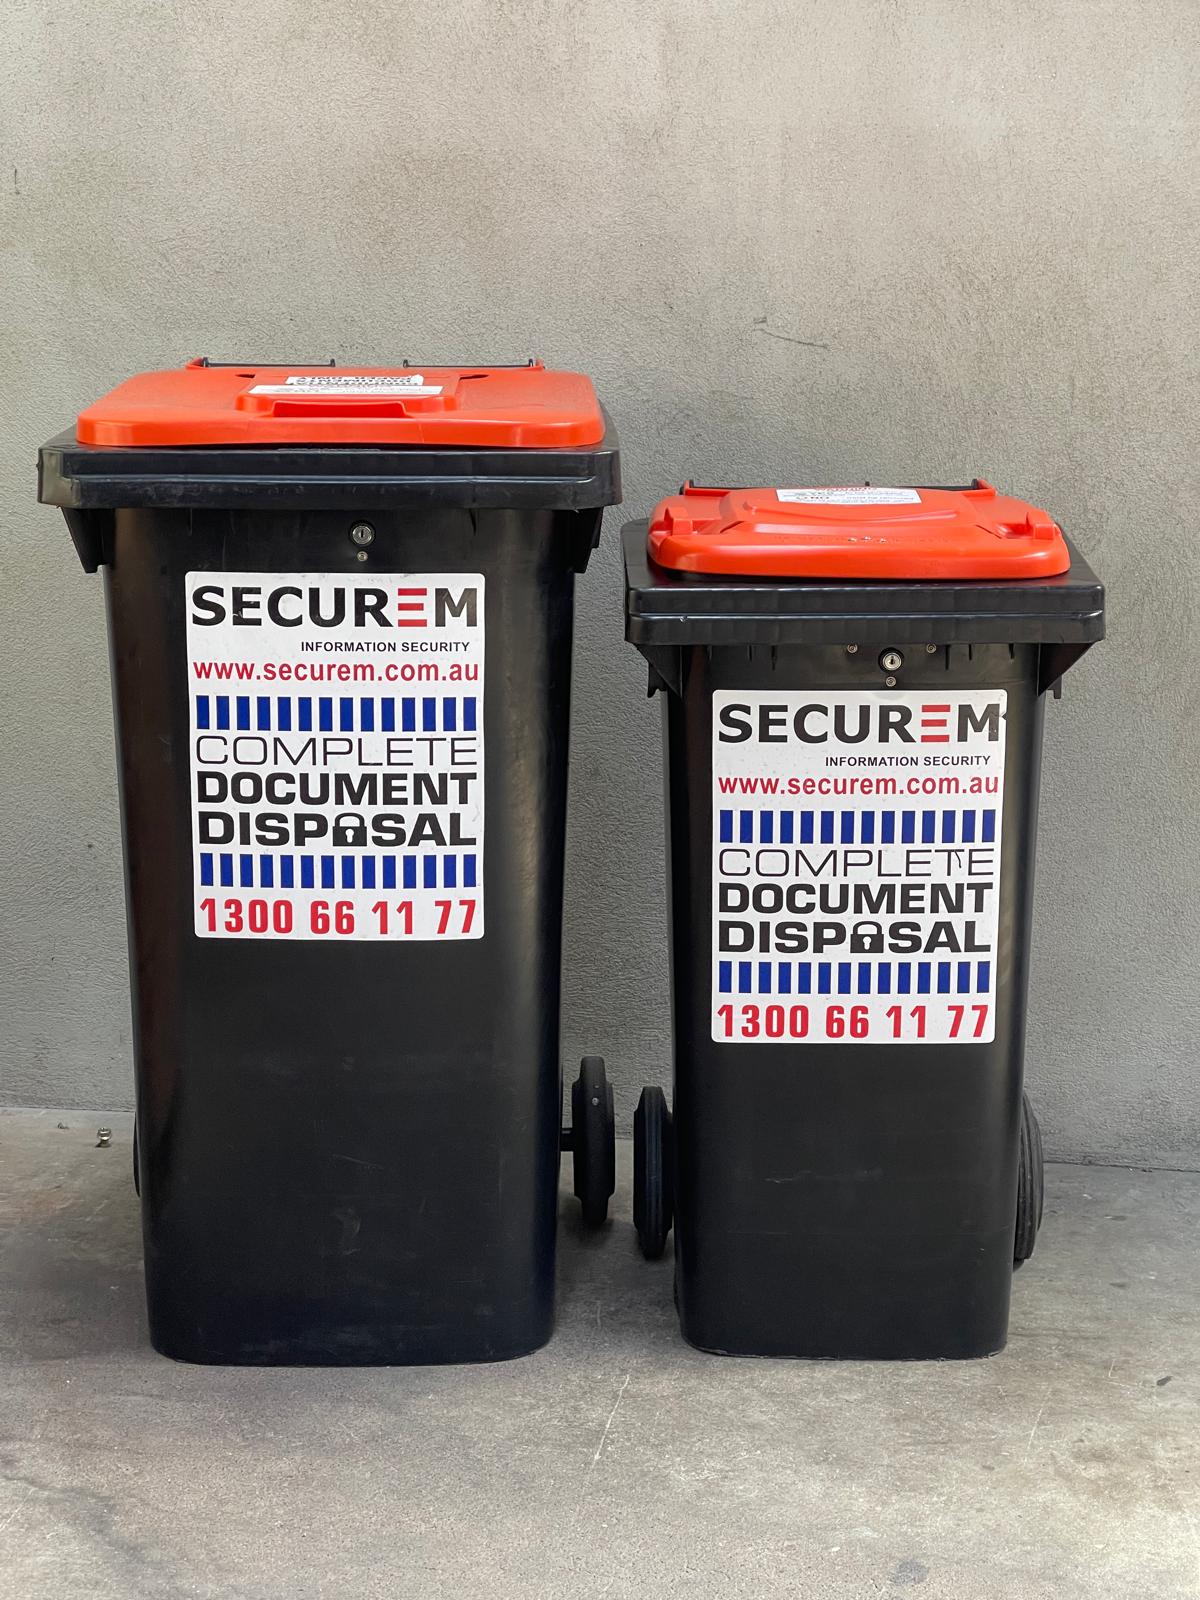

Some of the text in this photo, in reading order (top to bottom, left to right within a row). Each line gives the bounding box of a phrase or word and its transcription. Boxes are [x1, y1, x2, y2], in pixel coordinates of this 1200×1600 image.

[193, 586, 477, 627] SECUREM
[302, 642, 469, 651] INFORMATION SECURITY
[193, 662, 478, 681] www.securem.com.au
[719, 704, 999, 743] SECUREM
[197, 736, 477, 766] COMPLETE
[826, 756, 990, 766] INFORMATION SECURITY
[197, 771, 477, 805] DOCUMENT
[719, 777, 998, 794] www.securem.com.au
[719, 849, 994, 877] COMPLETE
[719, 882, 993, 914] DOCUMENT
[200, 898, 475, 934] 1300 66 11 77
[718, 1005, 988, 1038] 1300 66 11 77
